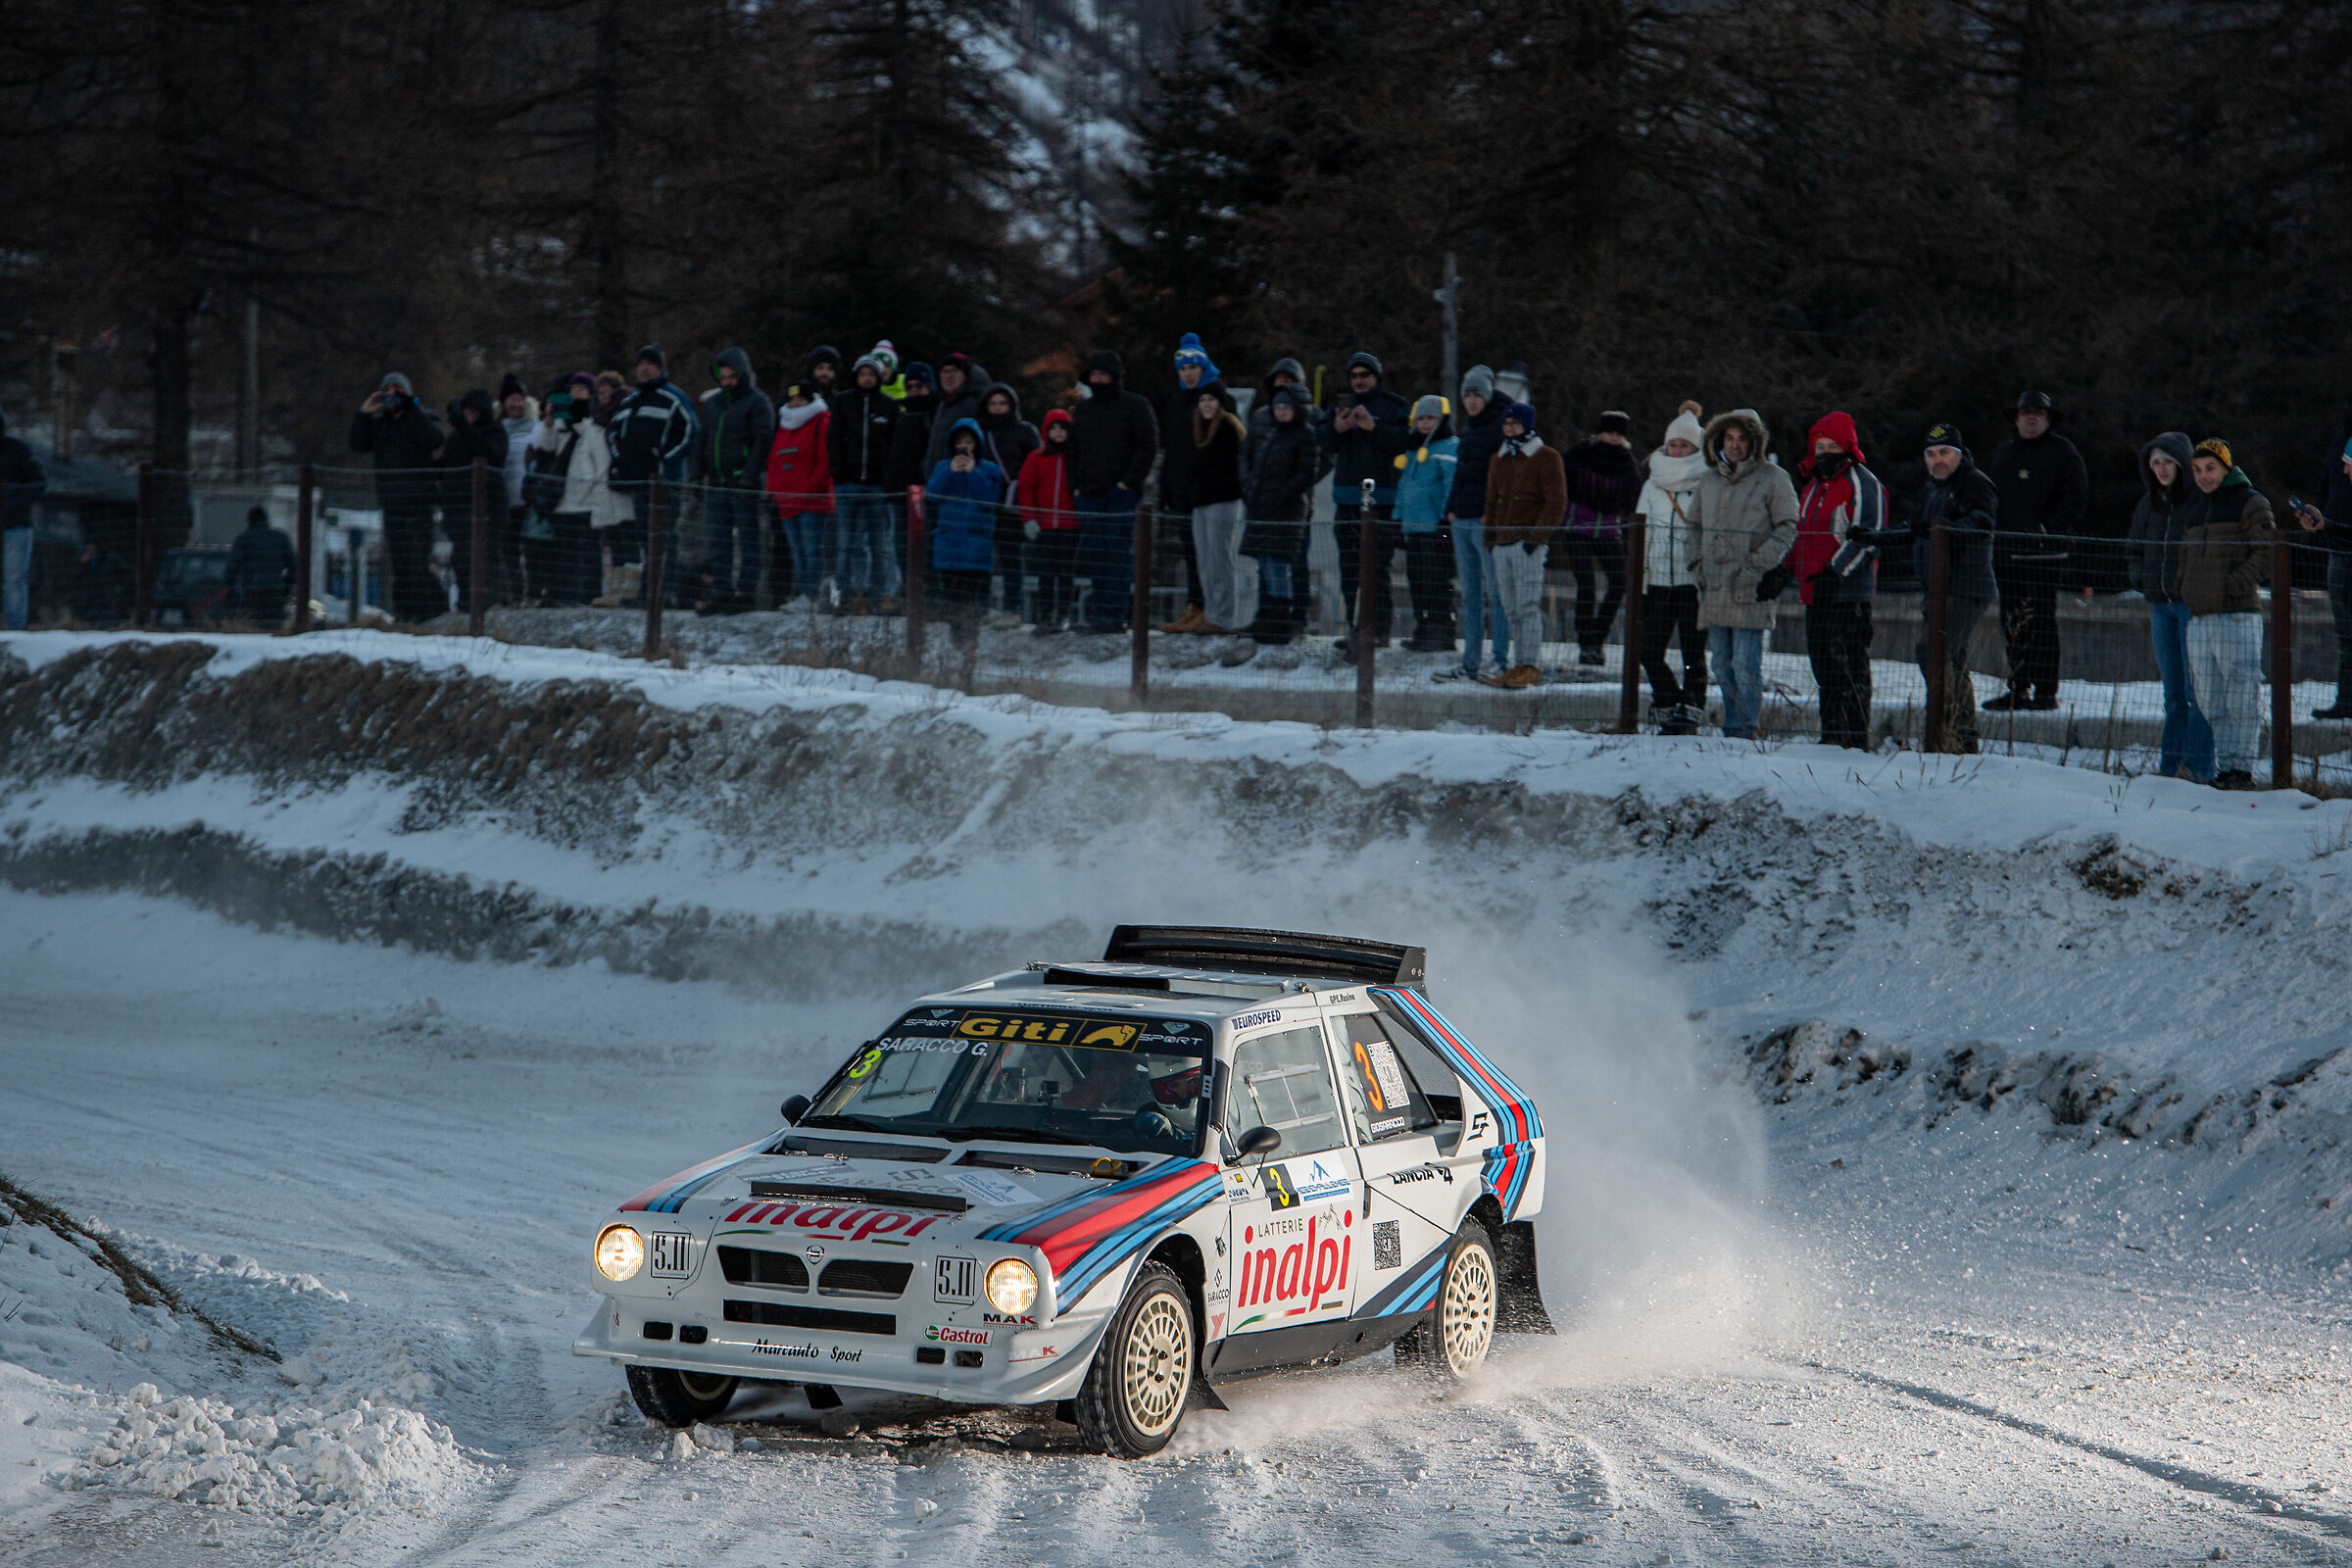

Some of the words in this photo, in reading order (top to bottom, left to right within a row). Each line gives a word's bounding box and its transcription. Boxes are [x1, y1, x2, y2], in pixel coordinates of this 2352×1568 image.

[959, 1017, 1070, 1042] Giti
[1238, 1009, 1282, 1029] EUROSPEED
[878, 1038, 969, 1055] SARACCO
[850, 1050, 882, 1078] 3
[1354, 1042, 1384, 1112] 3
[1268, 1167, 1290, 1207] 3
[1257, 1218, 1303, 1238] LATTERIE
[1238, 1209, 1352, 1312] inalpi
[983, 1313, 1038, 1326] MAK
[940, 1327, 989, 1346] Castrol
[752, 1338, 820, 1358] Marcauto
[830, 1346, 862, 1362] Sport
